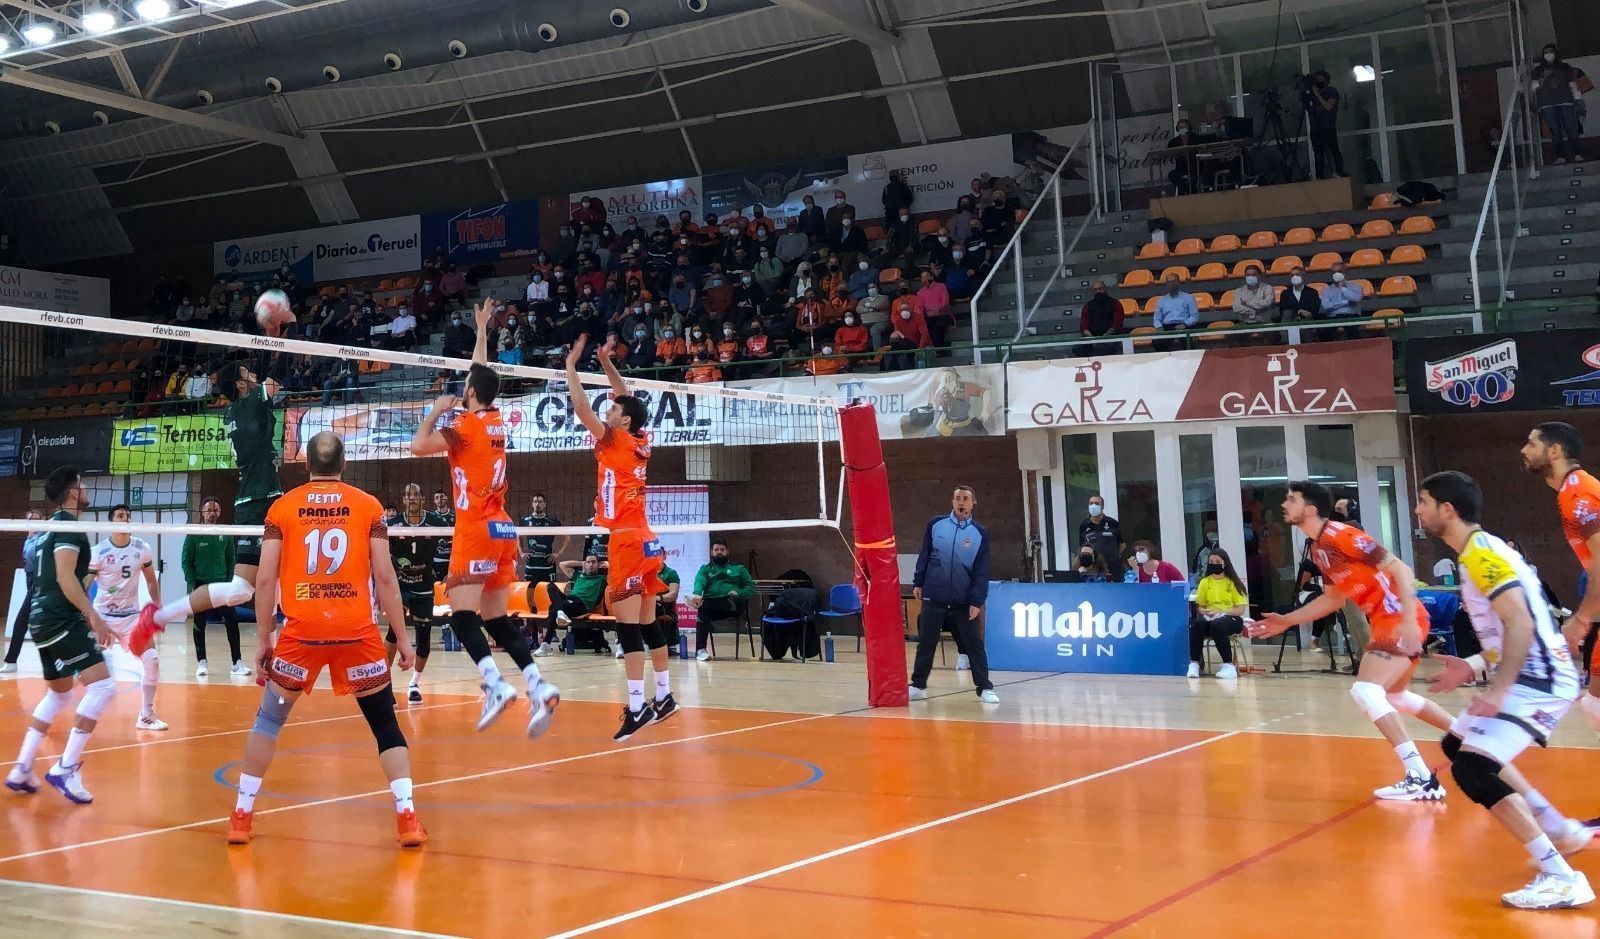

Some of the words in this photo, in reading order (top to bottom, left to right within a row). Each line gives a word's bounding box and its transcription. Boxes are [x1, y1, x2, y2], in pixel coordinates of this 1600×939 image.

[897, 163, 938, 177] ENTRO
[909, 180, 954, 193] TRICIÓN
[609, 185, 697, 206] MUTUA
[607, 197, 699, 217] SEGORBINA
[316, 242, 358, 260] Diario
[367, 233, 418, 252] Teruel
[243, 245, 299, 266] ARDENT
[40, 312, 84, 325] rfevb.com
[152, 326, 191, 338] rfevb.com
[251, 337, 285, 348] rfevb.com
[338, 347, 370, 358] rfevb.com
[418, 356, 446, 366] rfevb.com
[1429, 365, 1460, 387] San
[1459, 346, 1511, 374] Miguel
[1219, 373, 1357, 417] GARZA
[1031, 384, 1154, 425] GARZA
[39, 434, 75, 447] clepsidra
[163, 424, 226, 443] Temesa
[664, 429, 712, 443] TERUEL
[534, 435, 582, 449] CENTRO
[307, 493, 343, 504] PETTY
[299, 506, 350, 518] PAMESA
[304, 527, 348, 576] 19
[411, 541, 417, 555] 1
[121, 565, 132, 579] 5
[309, 582, 352, 592] GOBIERNO
[309, 590, 321, 599] DE
[1010, 600, 1163, 639] Mahou
[1057, 643, 1114, 657] SIN
